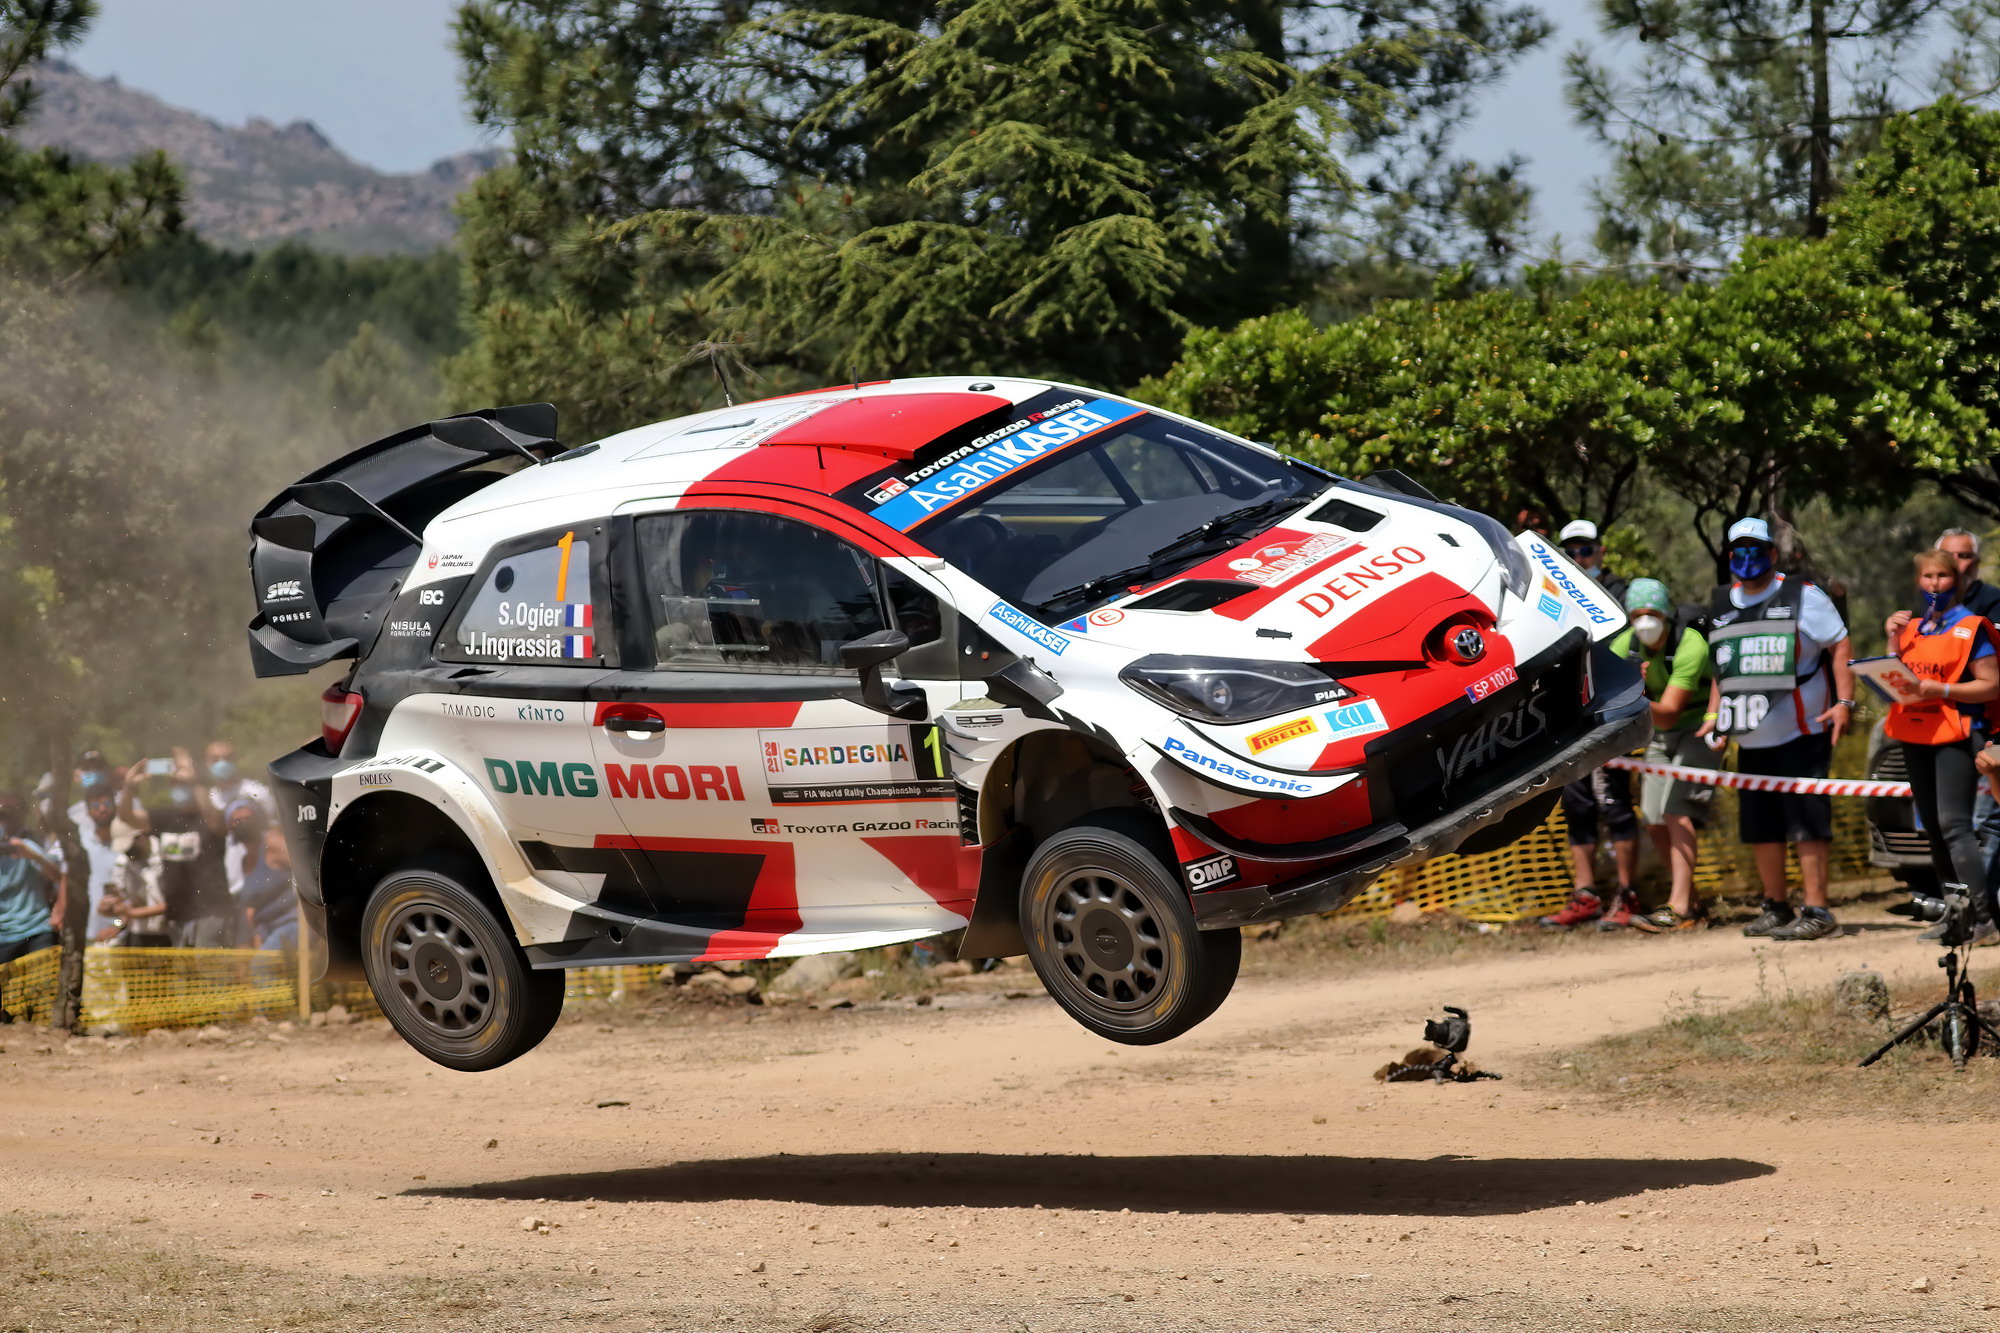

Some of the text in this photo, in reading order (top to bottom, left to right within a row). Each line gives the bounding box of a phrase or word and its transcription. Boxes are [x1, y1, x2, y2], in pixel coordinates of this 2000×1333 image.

[904, 398, 1086, 483] TOYOTA GAZOO Racing
[908, 408, 1113, 512] AsahiKASEI
[555, 531, 574, 601] 1
[267, 580, 305, 599] SWS
[1296, 546, 1426, 618] DENSO
[1530, 543, 1616, 624] Panasonic
[272, 611, 311, 623] PONSSE
[390, 621, 431, 631] NISULA
[498, 601, 562, 631] S.Ogier
[992, 605, 1068, 653] AsahiKASEI
[465, 631, 561, 661] J.Ingrassia
[1740, 636, 1787, 654] METEO
[1740, 655, 1785, 674] CREW
[1314, 688, 1347, 701] PIAA
[1474, 667, 1516, 698] SP 1012
[441, 702, 495, 718] TAMADIC
[1716, 693, 1769, 732] 618
[1251, 719, 1312, 750] PIRELLI
[783, 743, 909, 767] SARDEGNA
[924, 726, 945, 777] 1
[1163, 737, 1312, 792] Panasonic
[359, 773, 393, 786] ENDLESS
[483, 758, 746, 801] DMG MORI
[803, 790, 818, 798] FIA
[818, 788, 842, 798] World
[844, 787, 865, 798] Rally
[866, 786, 921, 797] Championship
[297, 805, 317, 822] JTB
[783, 818, 959, 834] TOYOTA GAZOO Racin
[752, 824, 780, 834] GR
[1188, 858, 1233, 885] OMP
